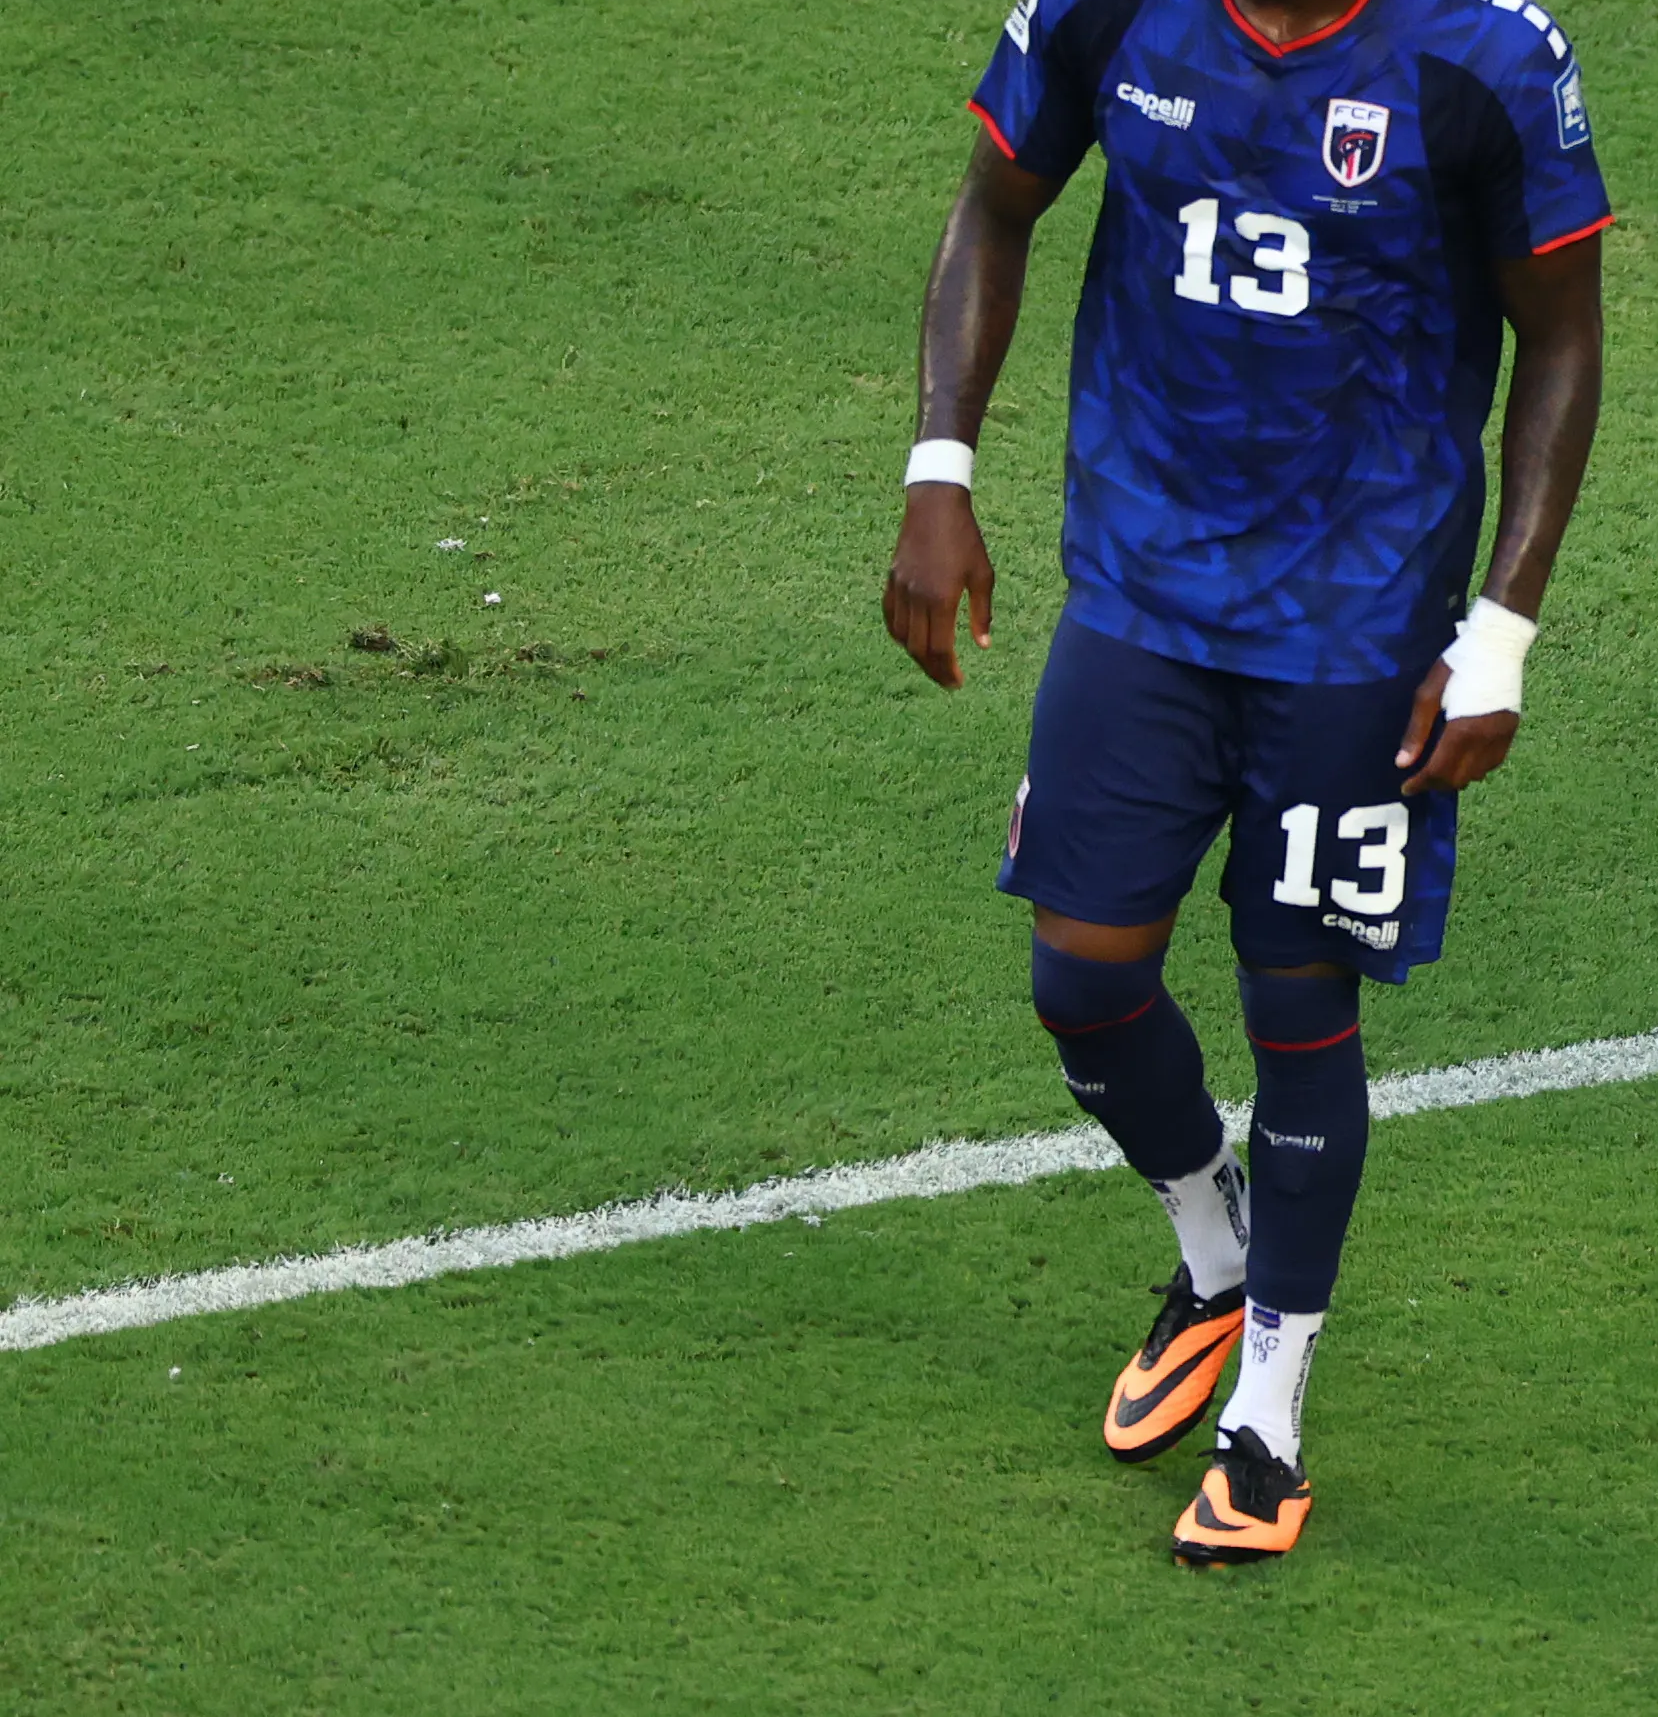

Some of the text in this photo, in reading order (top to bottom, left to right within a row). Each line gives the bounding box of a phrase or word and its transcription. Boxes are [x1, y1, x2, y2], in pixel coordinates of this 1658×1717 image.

[1116, 81, 1196, 124] capelli
[1335, 104, 1385, 122] FCF
[1174, 198, 1311, 317] 13
[1273, 801, 1409, 916] 13
[1322, 913, 1400, 943] capelli
